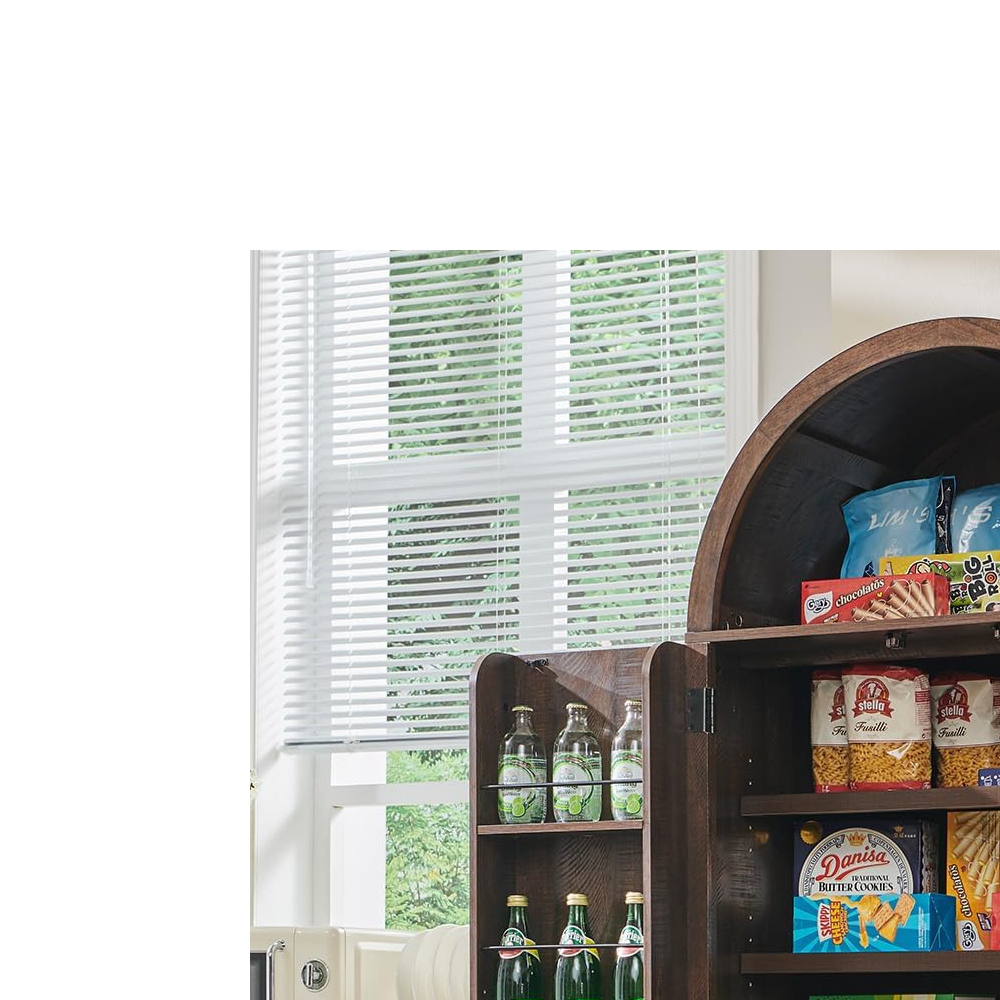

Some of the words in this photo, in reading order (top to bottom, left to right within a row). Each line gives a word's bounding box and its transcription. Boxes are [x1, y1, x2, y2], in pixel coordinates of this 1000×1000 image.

[868, 506, 930, 531] LIM'S
[964, 556, 988, 603] BIG
[858, 699, 885, 713] stella
[940, 705, 964, 717] stella
[854, 721, 888, 733] Fusilli
[938, 726, 967, 738] Fusilli
[815, 846, 891, 881] Danisa
[819, 882, 853, 892] BUTTER
[854, 882, 894, 892] COOKIES
[820, 904, 832, 938] SKIPPY
[830, 900, 843, 945] CHEESE
